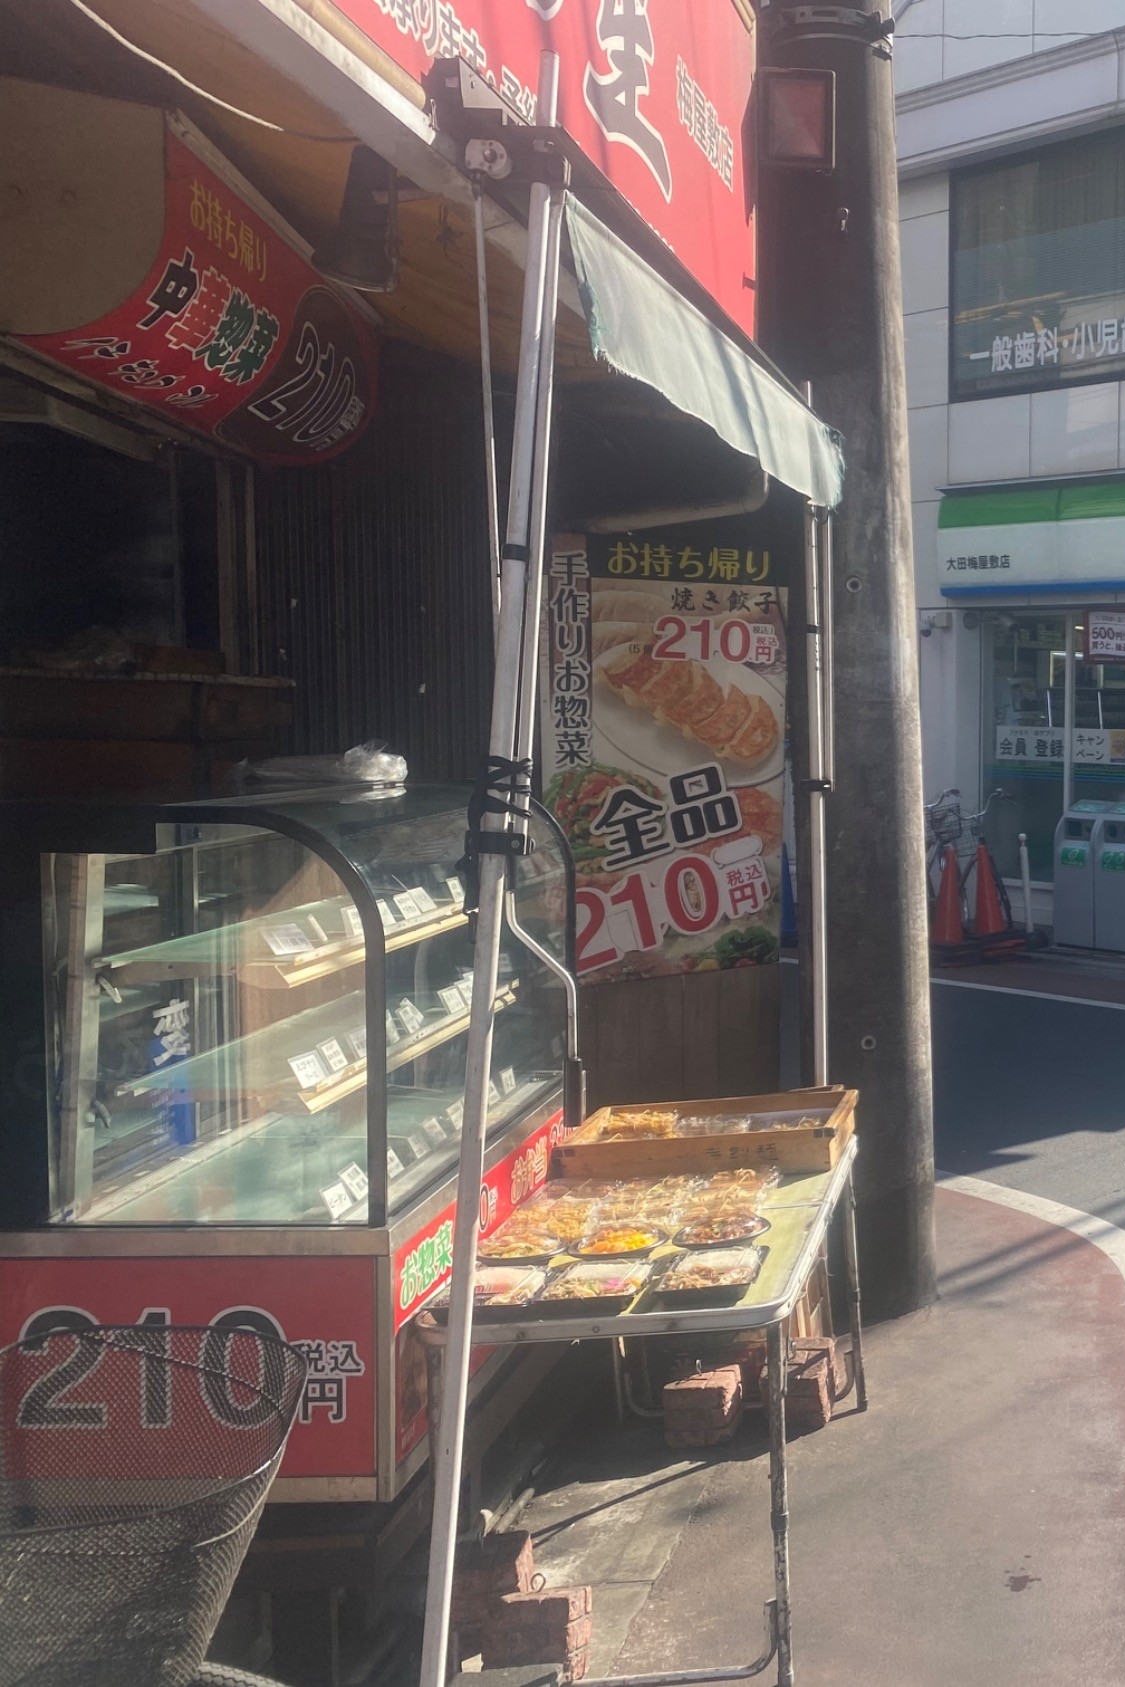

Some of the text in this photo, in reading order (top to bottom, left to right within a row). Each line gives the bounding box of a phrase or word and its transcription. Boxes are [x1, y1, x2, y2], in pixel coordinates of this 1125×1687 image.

[676, 54, 733, 193] 梅屋敷店
[189, 179, 267, 282] お持ち帰り
[136, 246, 280, 386] 中華惣菜
[607, 541, 770, 582] お持ち帰り
[946, 554, 1010, 571] 大田梅屋敷店
[671, 586, 778, 614] 焼き餃子
[552, 551, 591, 767] 手作りお惣菜
[652, 615, 751, 662] 210
[755, 647, 771, 662] 円
[756, 636, 777, 647] 税込
[592, 765, 740, 868] 全品
[726, 865, 763, 886] 税込
[728, 882, 760, 915] 円
[575, 857, 720, 974] 210
[510, 1135, 548, 1205] お弁当
[401, 1220, 453, 1310] お惣菜
[16, 1305, 288, 1430] 210
[287, 1341, 364, 1376] 税込
